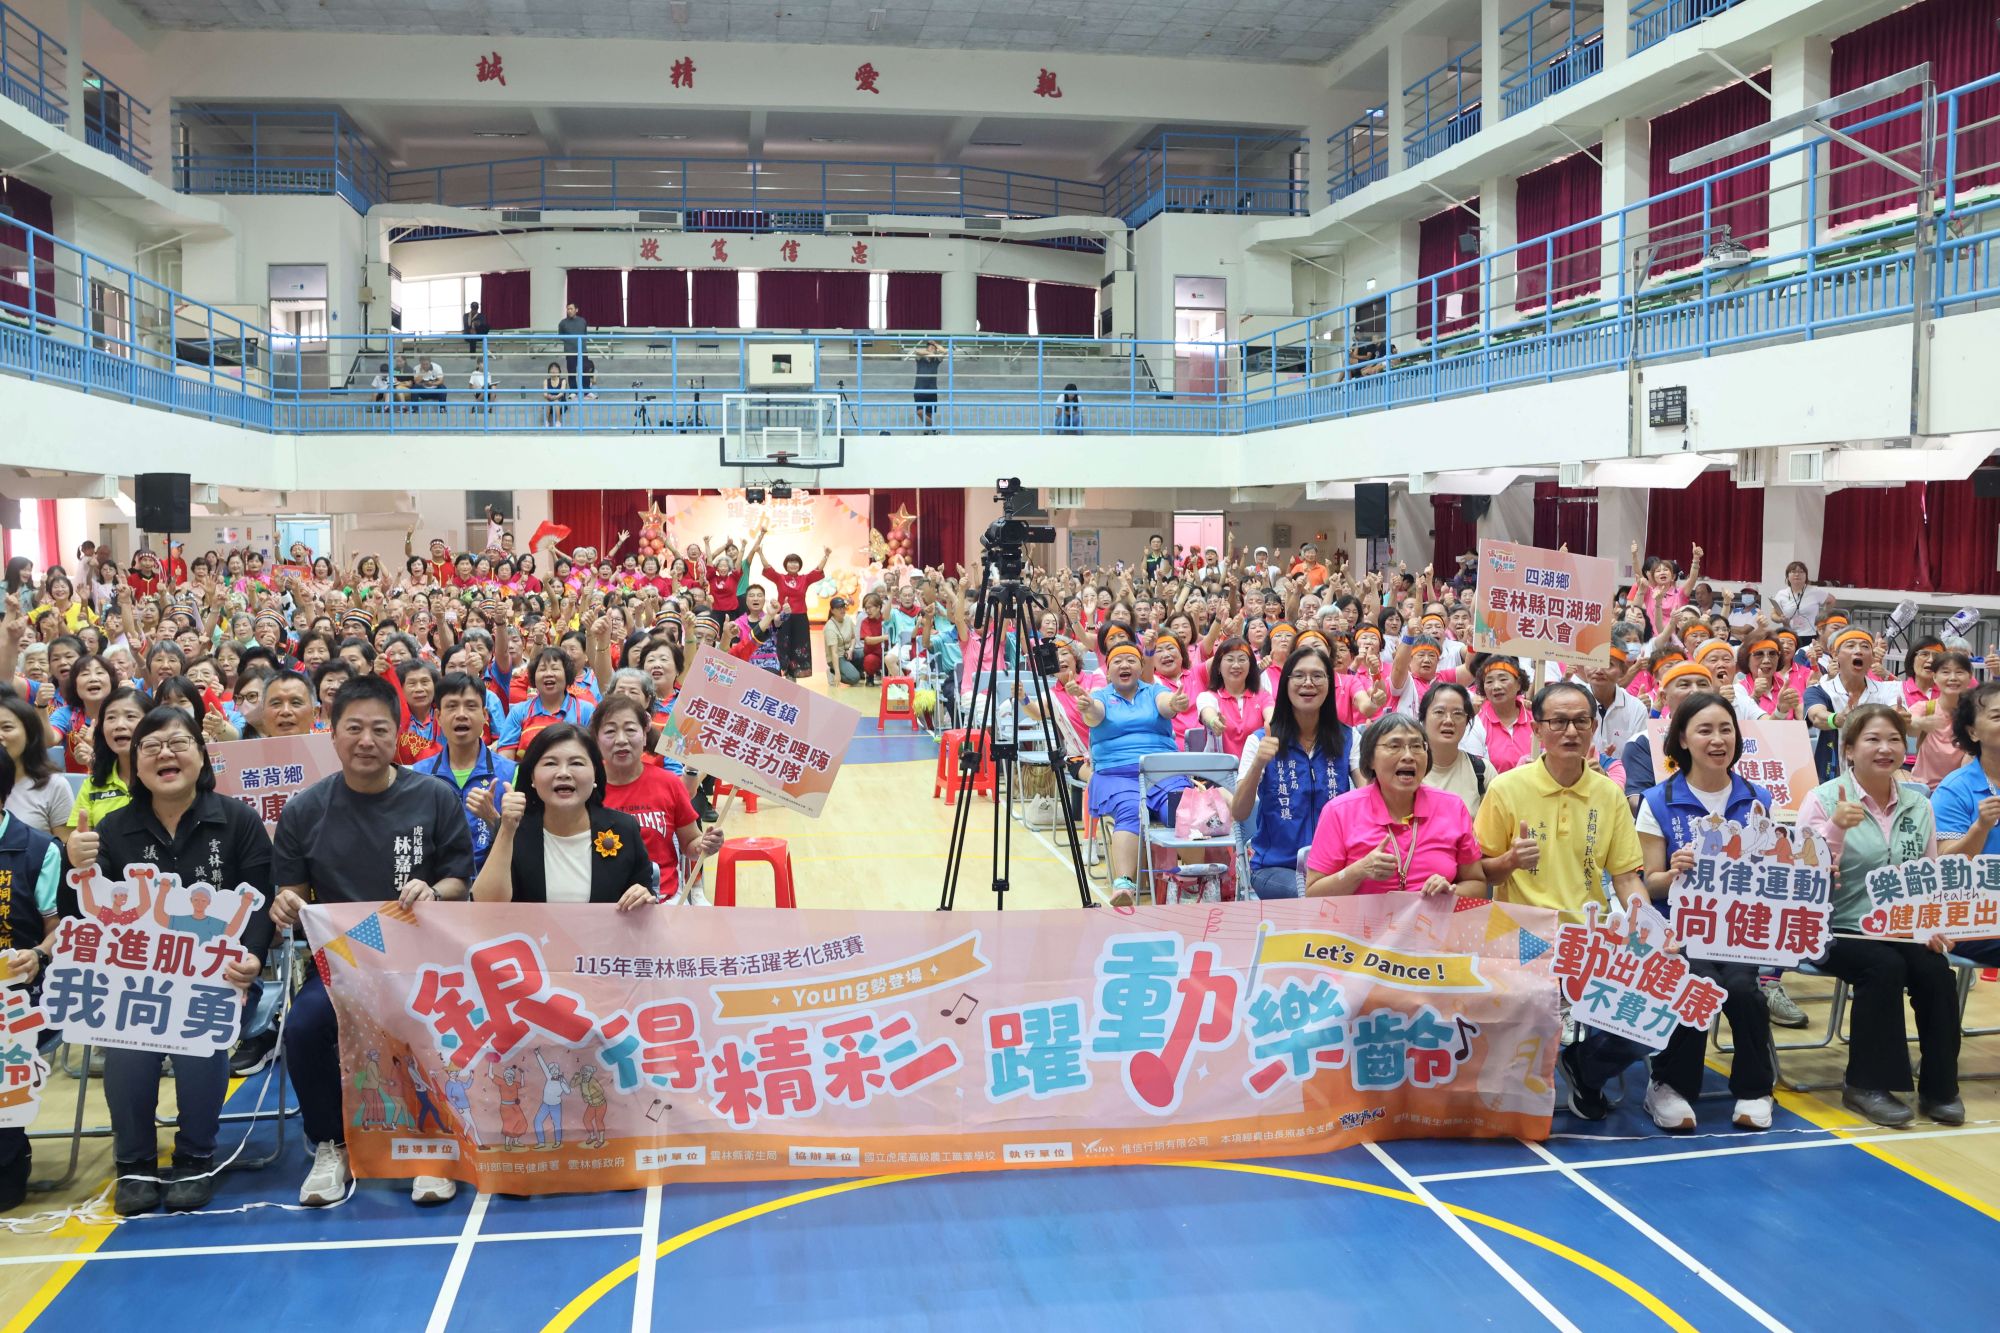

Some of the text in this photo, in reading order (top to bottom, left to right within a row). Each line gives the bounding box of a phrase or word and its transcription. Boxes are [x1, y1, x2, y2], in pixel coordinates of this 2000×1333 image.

[1525, 568, 1570, 590] 四湖鄉
[1490, 588, 1602, 624] 雲林縣四湖鄉
[1518, 616, 1573, 644] 老人會
[740, 688, 800, 725] 虎尾鎮
[700, 725, 802, 782] 不老活力隊
[241, 765, 304, 789] 崙背鄉
[1731, 760, 1785, 781] 健康
[477, 817, 490, 846] 政府
[1682, 859, 1828, 904] 規律運動
[1933, 887, 1980, 902] Health
[1676, 895, 1825, 956] 尚健康
[1889, 899, 1998, 931] 健康更出
[56, 920, 243, 981] 增進肌力
[575, 935, 865, 978] 115年雲林縣長者活躍老化競賽
[1304, 942, 1354, 964] Let's
[1363, 953, 1431, 981] Dance
[1553, 926, 1725, 1028] 動出健康
[46, 967, 237, 1045] 我尚勇
[1583, 979, 1679, 1038] 不費力
[397, 1144, 453, 1155] 指導單位
[568, 1156, 625, 1170] 雲林縣政府
[642, 1151, 698, 1164] 主辦單位
[710, 1149, 777, 1162] 雲林縣衛生局
[795, 1151, 852, 1162] 協辦單位
[1009, 1148, 1065, 1159] 執行單位
